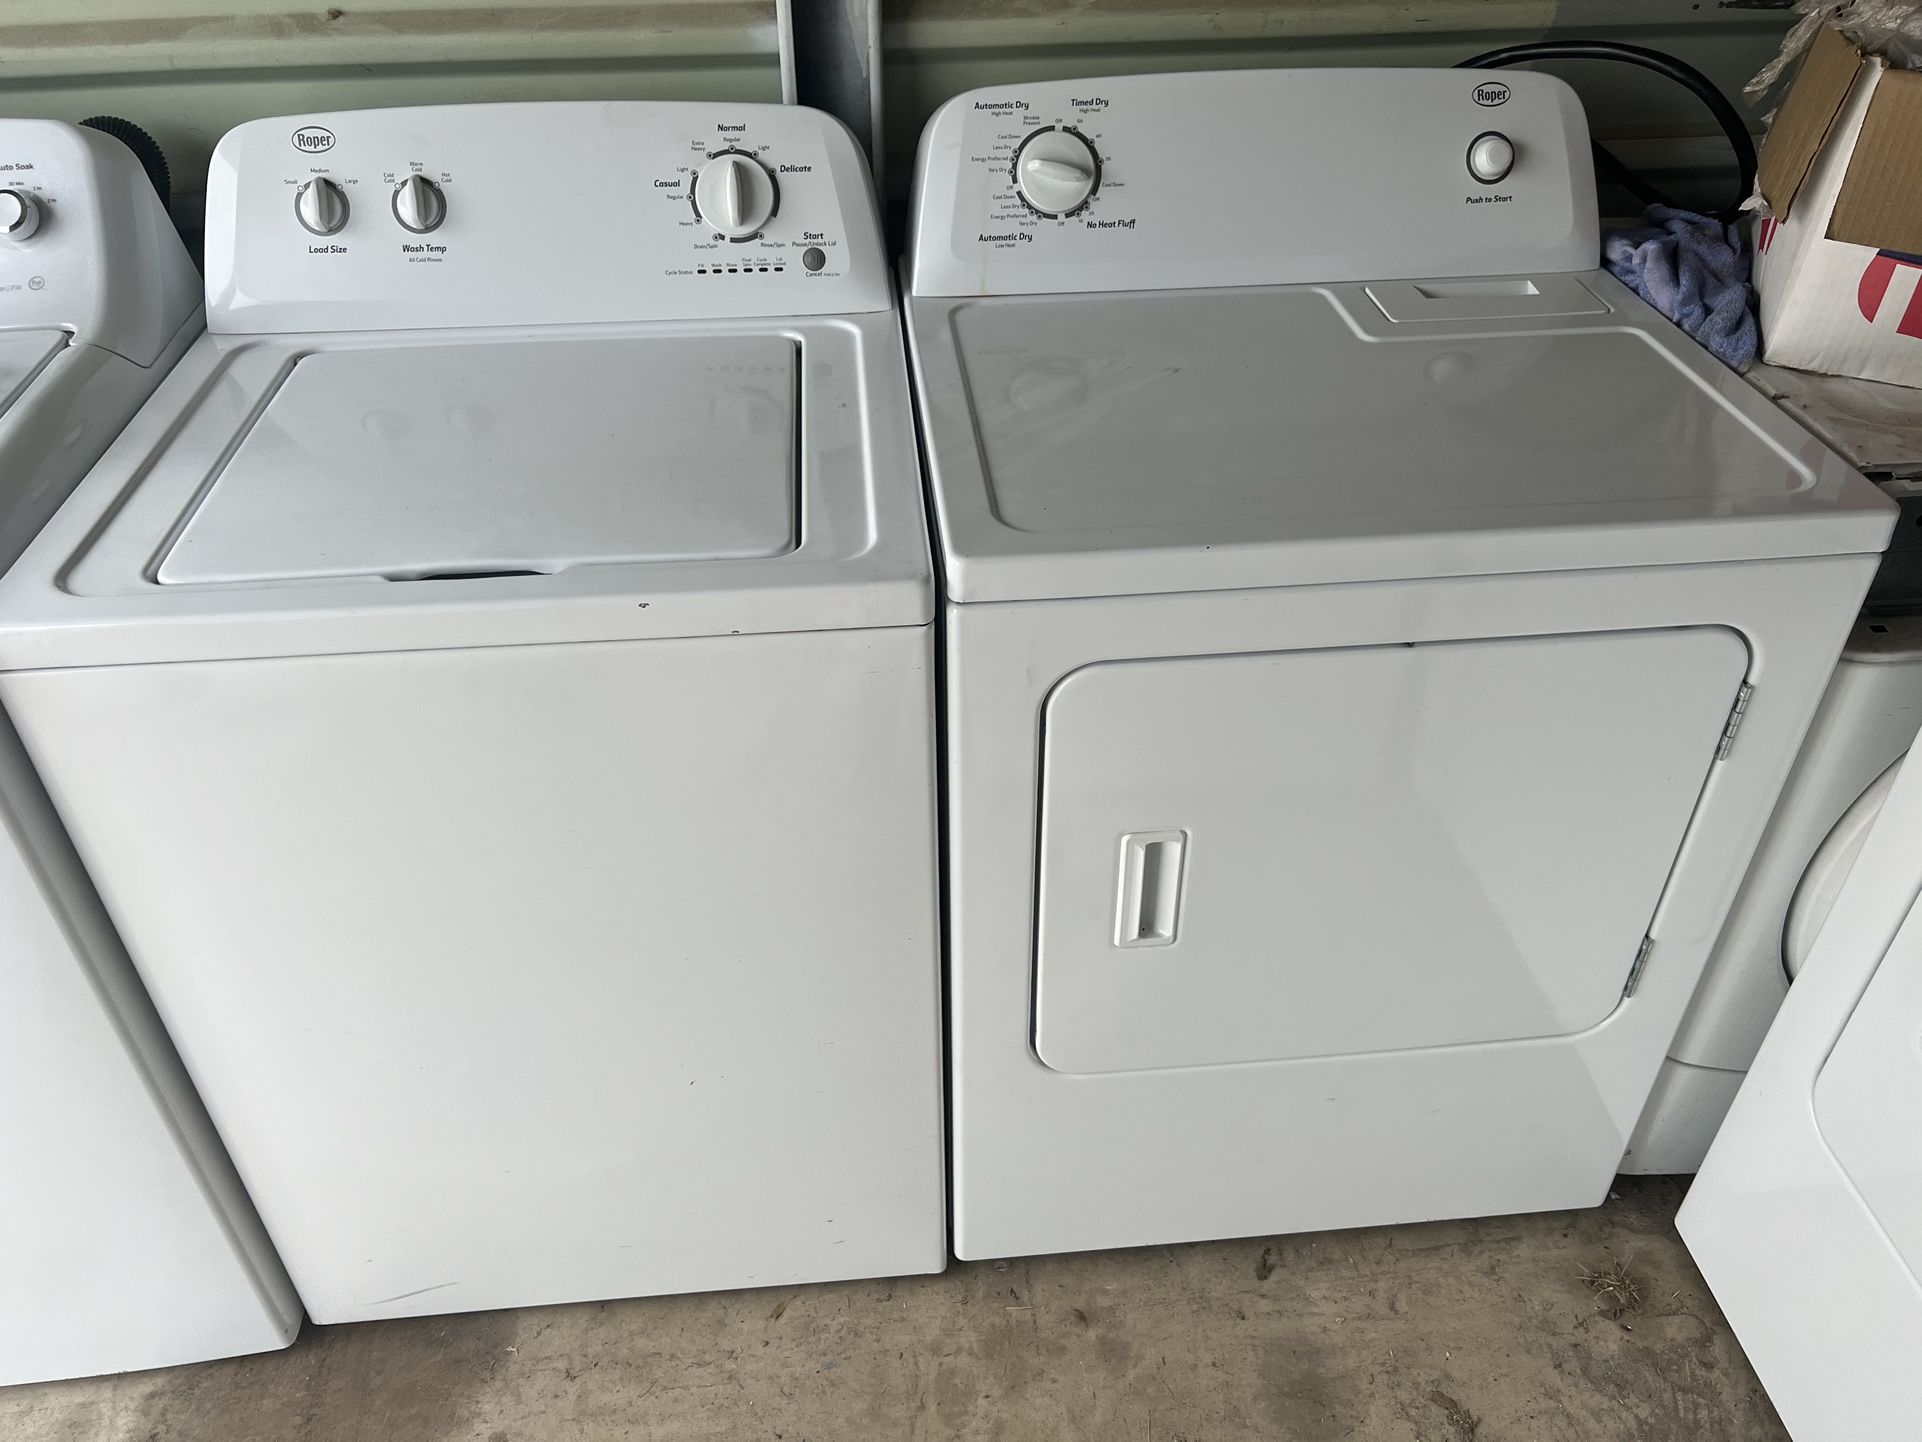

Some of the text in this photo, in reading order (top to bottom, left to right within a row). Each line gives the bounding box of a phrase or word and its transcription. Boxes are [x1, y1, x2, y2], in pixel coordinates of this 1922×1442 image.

[1477, 88, 1507, 103] Roper
[974, 100, 1030, 111] Automatic Dry
[1071, 97, 1109, 108] Timed Dry
[717, 123, 745, 132] Normal
[297, 133, 331, 149] Roper
[15, 162, 34, 170] Soak
[779, 164, 812, 173] Delicate
[654, 179, 680, 188] Casual
[1465, 194, 1513, 204] Push to Start
[1086, 218, 1136, 229] No Heat Fluff
[803, 232, 823, 240] Start
[978, 232, 1033, 243] Automatic Dry
[308, 245, 348, 254] Load Size
[402, 244, 447, 254] Wash Temp
